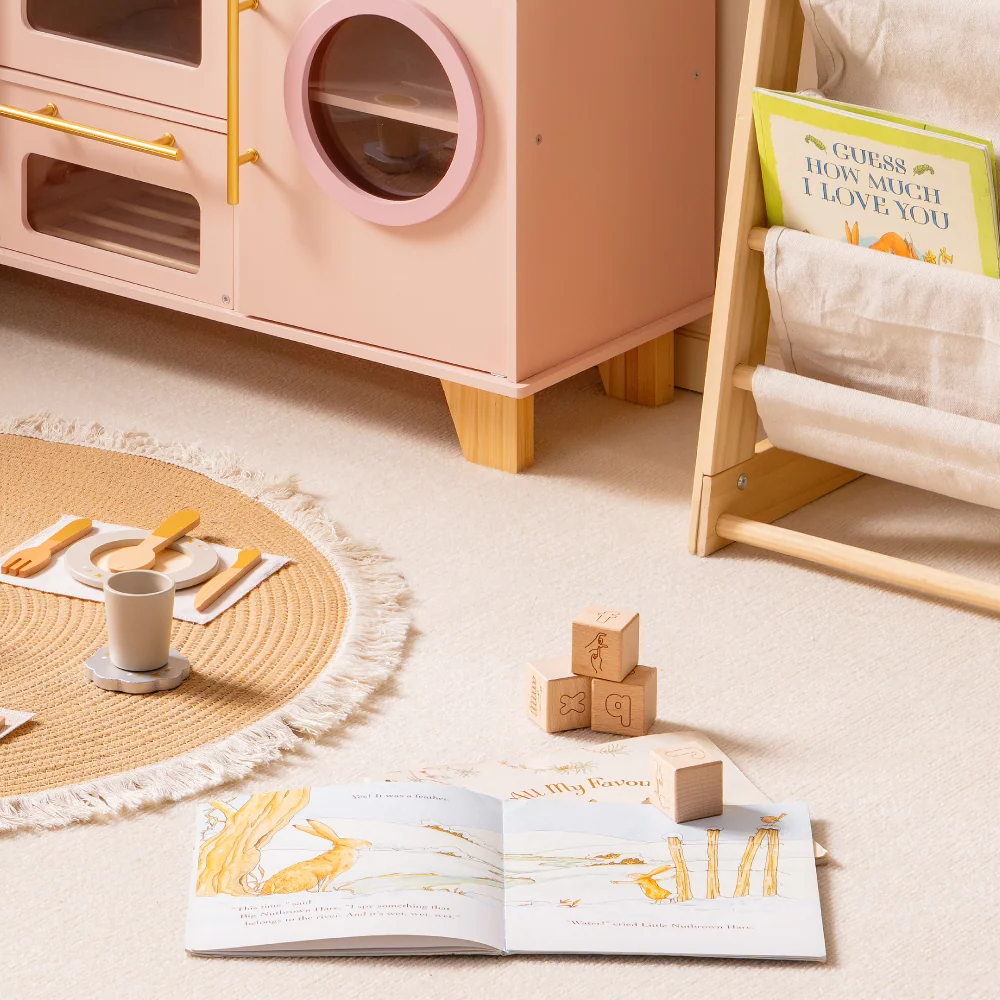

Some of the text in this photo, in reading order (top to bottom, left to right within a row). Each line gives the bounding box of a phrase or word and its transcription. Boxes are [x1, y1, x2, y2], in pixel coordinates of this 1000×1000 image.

[832, 142, 907, 175] GUESS
[804, 156, 942, 205] HOW MUCH
[802, 176, 950, 230] I LOVE YOU
[509, 788, 546, 800] All
[545, 782, 587, 796] My
[377, 902, 428, 911] something
[245, 918, 282, 926] belongs
